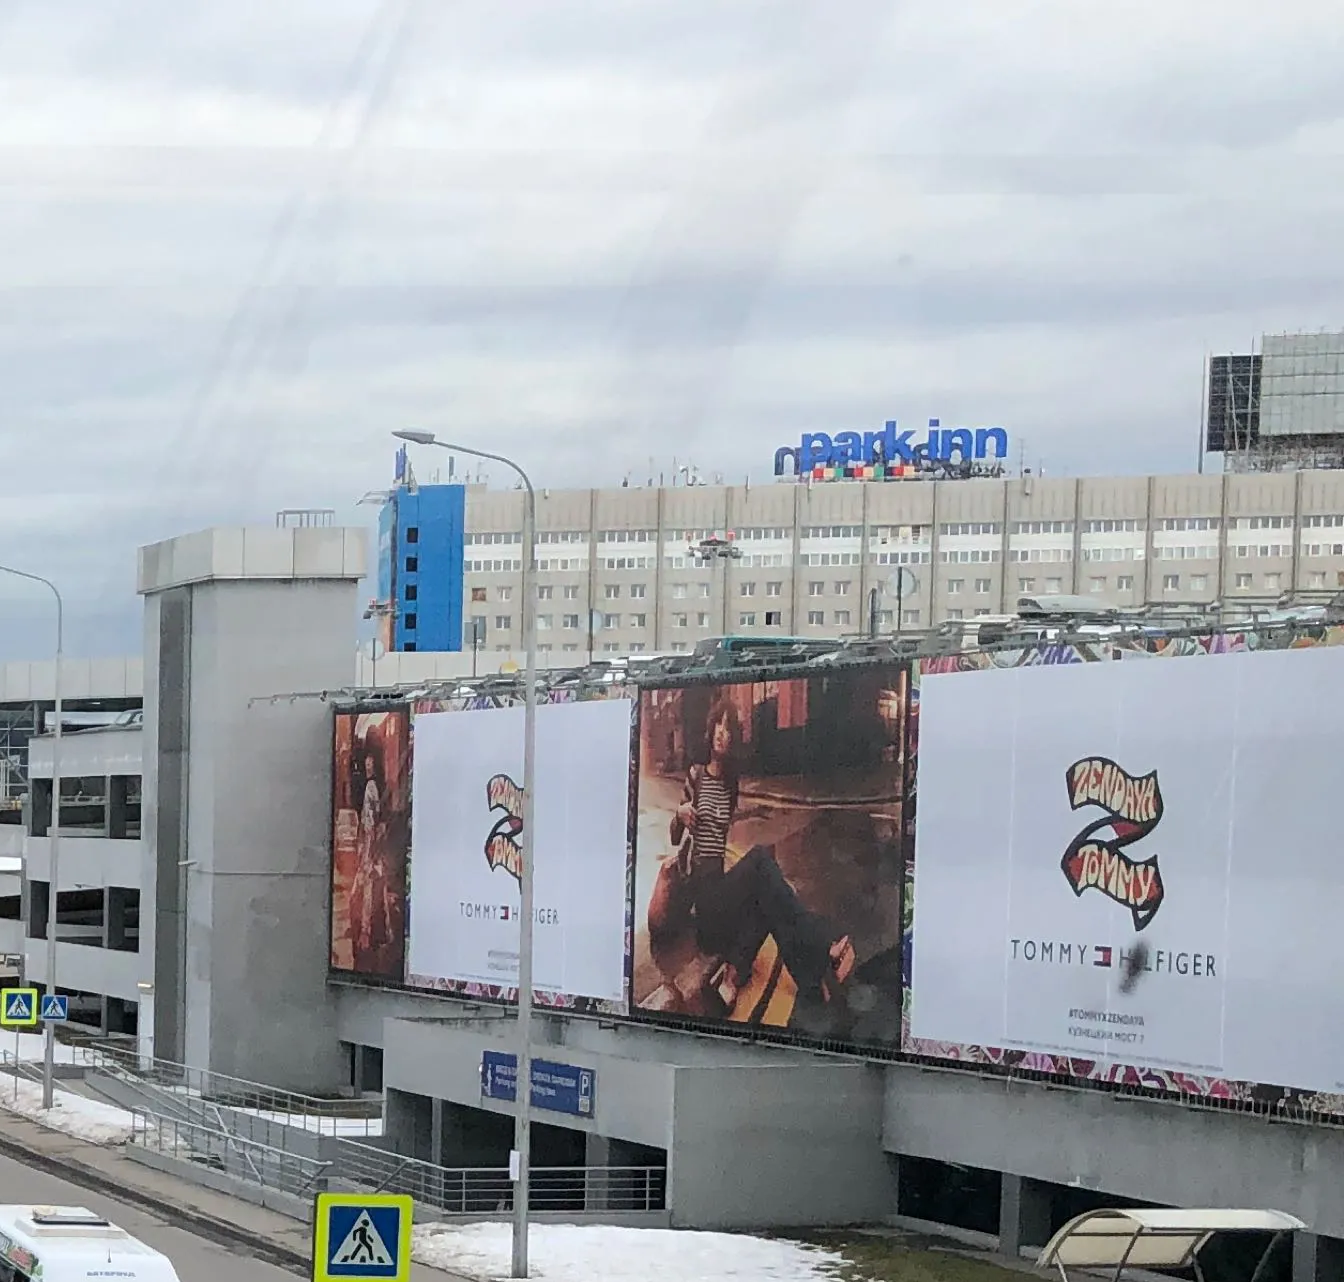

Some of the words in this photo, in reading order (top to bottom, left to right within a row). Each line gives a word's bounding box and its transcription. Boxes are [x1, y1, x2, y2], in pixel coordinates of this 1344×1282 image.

[801, 421, 916, 472] park
[928, 418, 1008, 460] inn
[1074, 760, 1157, 822] ZENDAYA
[1078, 844, 1156, 906] TOMMY
[460, 902, 497, 920] TOMMY
[512, 907, 560, 925] HIGER
[1011, 940, 1088, 965] TOMMY
[1119, 948, 1217, 977] HLFIGER
